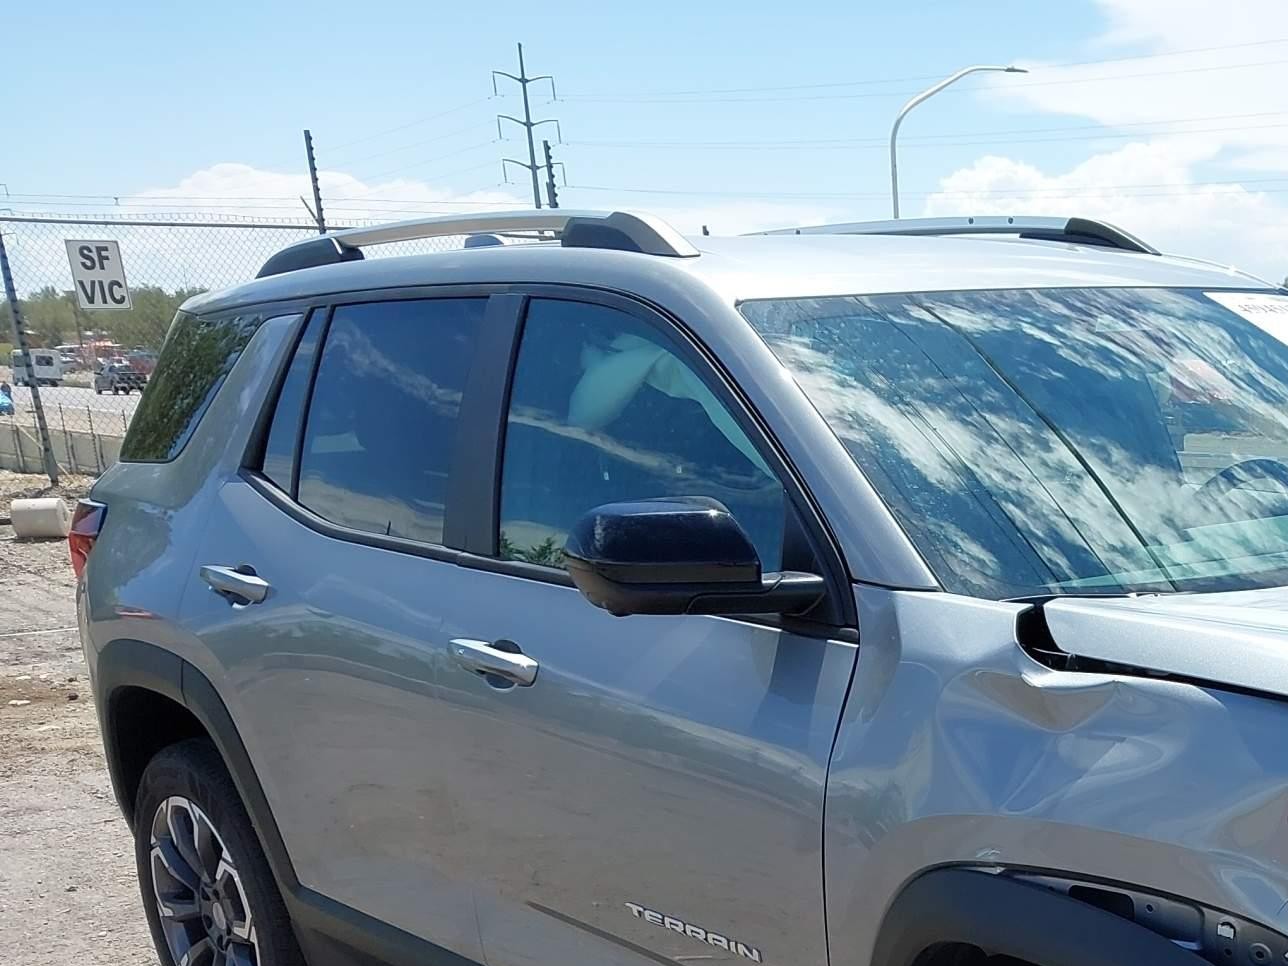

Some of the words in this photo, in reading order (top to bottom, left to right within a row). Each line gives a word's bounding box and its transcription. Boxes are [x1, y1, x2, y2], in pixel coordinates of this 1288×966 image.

[78, 245, 110, 271] SF
[77, 279, 126, 305] VIC
[624, 901, 763, 963] TERRAIN
